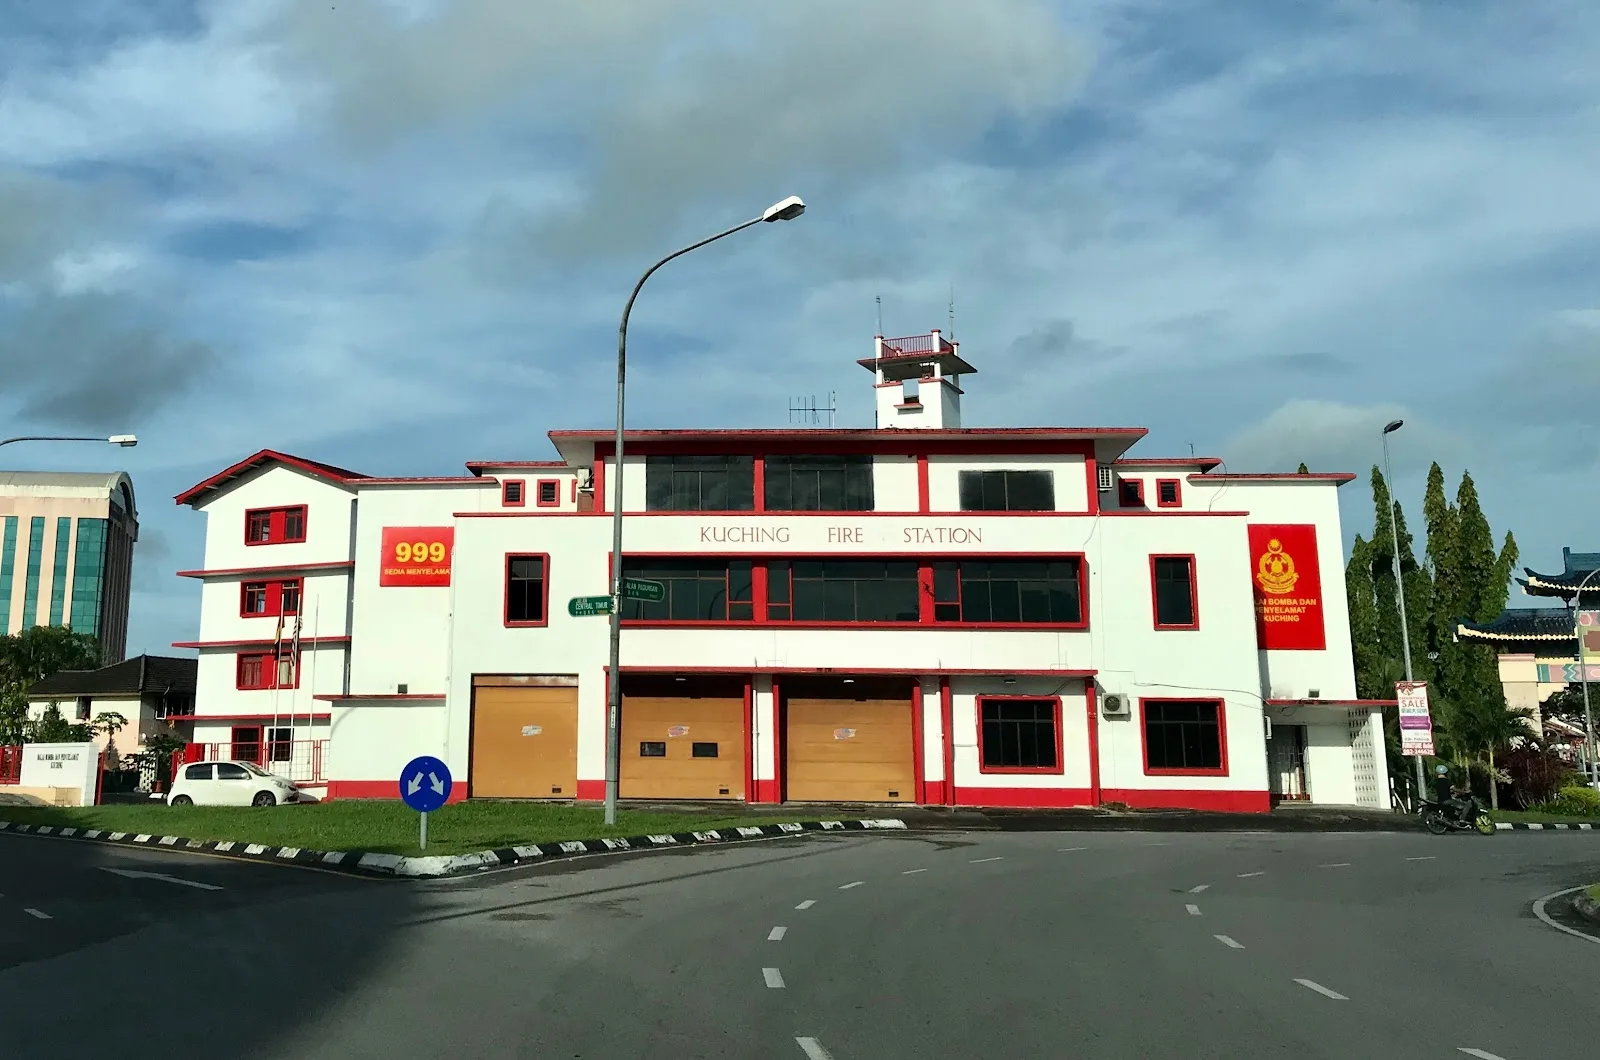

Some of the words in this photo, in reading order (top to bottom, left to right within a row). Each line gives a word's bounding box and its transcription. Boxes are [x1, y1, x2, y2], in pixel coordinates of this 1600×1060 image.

[700, 526, 790, 543] KUCHING
[827, 527, 864, 543] FIRE
[903, 527, 982, 544] STATION
[395, 541, 446, 563] 999
[575, 602, 593, 610] CENTRAL
[1268, 598, 1298, 606] BOMBA
[1299, 598, 1317, 606] DAN
[1264, 614, 1300, 622] KUCHING
[1401, 700, 1426, 708] SALE
